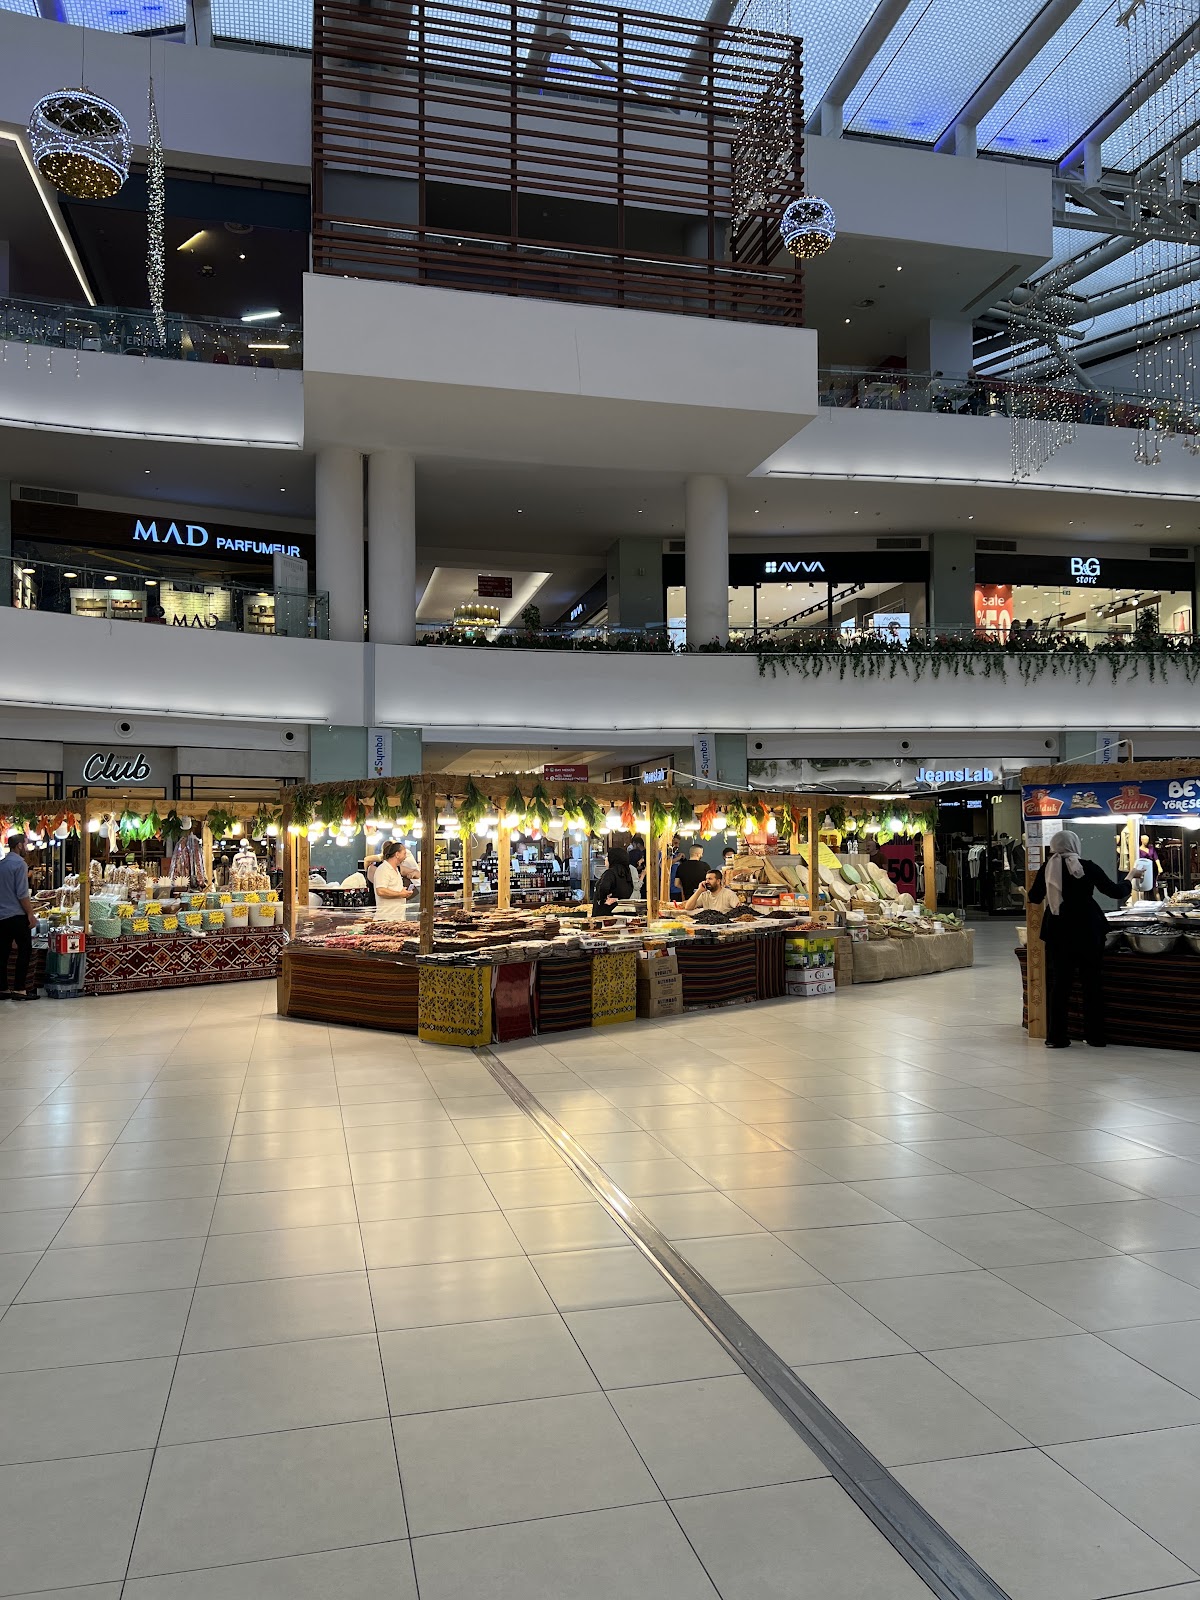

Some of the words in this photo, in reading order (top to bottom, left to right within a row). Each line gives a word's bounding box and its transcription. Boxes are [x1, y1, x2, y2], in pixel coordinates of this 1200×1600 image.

[132, 519, 209, 547] MAD
[216, 537, 301, 558] PARFUMEUR
[777, 561, 826, 573] AVVA
[1070, 557, 1101, 577] B&G
[1075, 575, 1097, 585] store
[982, 594, 1005, 606] sale
[374, 734, 386, 766] Symbol
[699, 740, 711, 769] Symbol
[83, 752, 152, 783] Club
[915, 767, 994, 783] JeansLab
[1168, 779, 1200, 799] BE
[1025, 802, 1058, 813] Bulduk
[1113, 799, 1150, 811] Bulduk
[887, 858, 915, 884] 50
